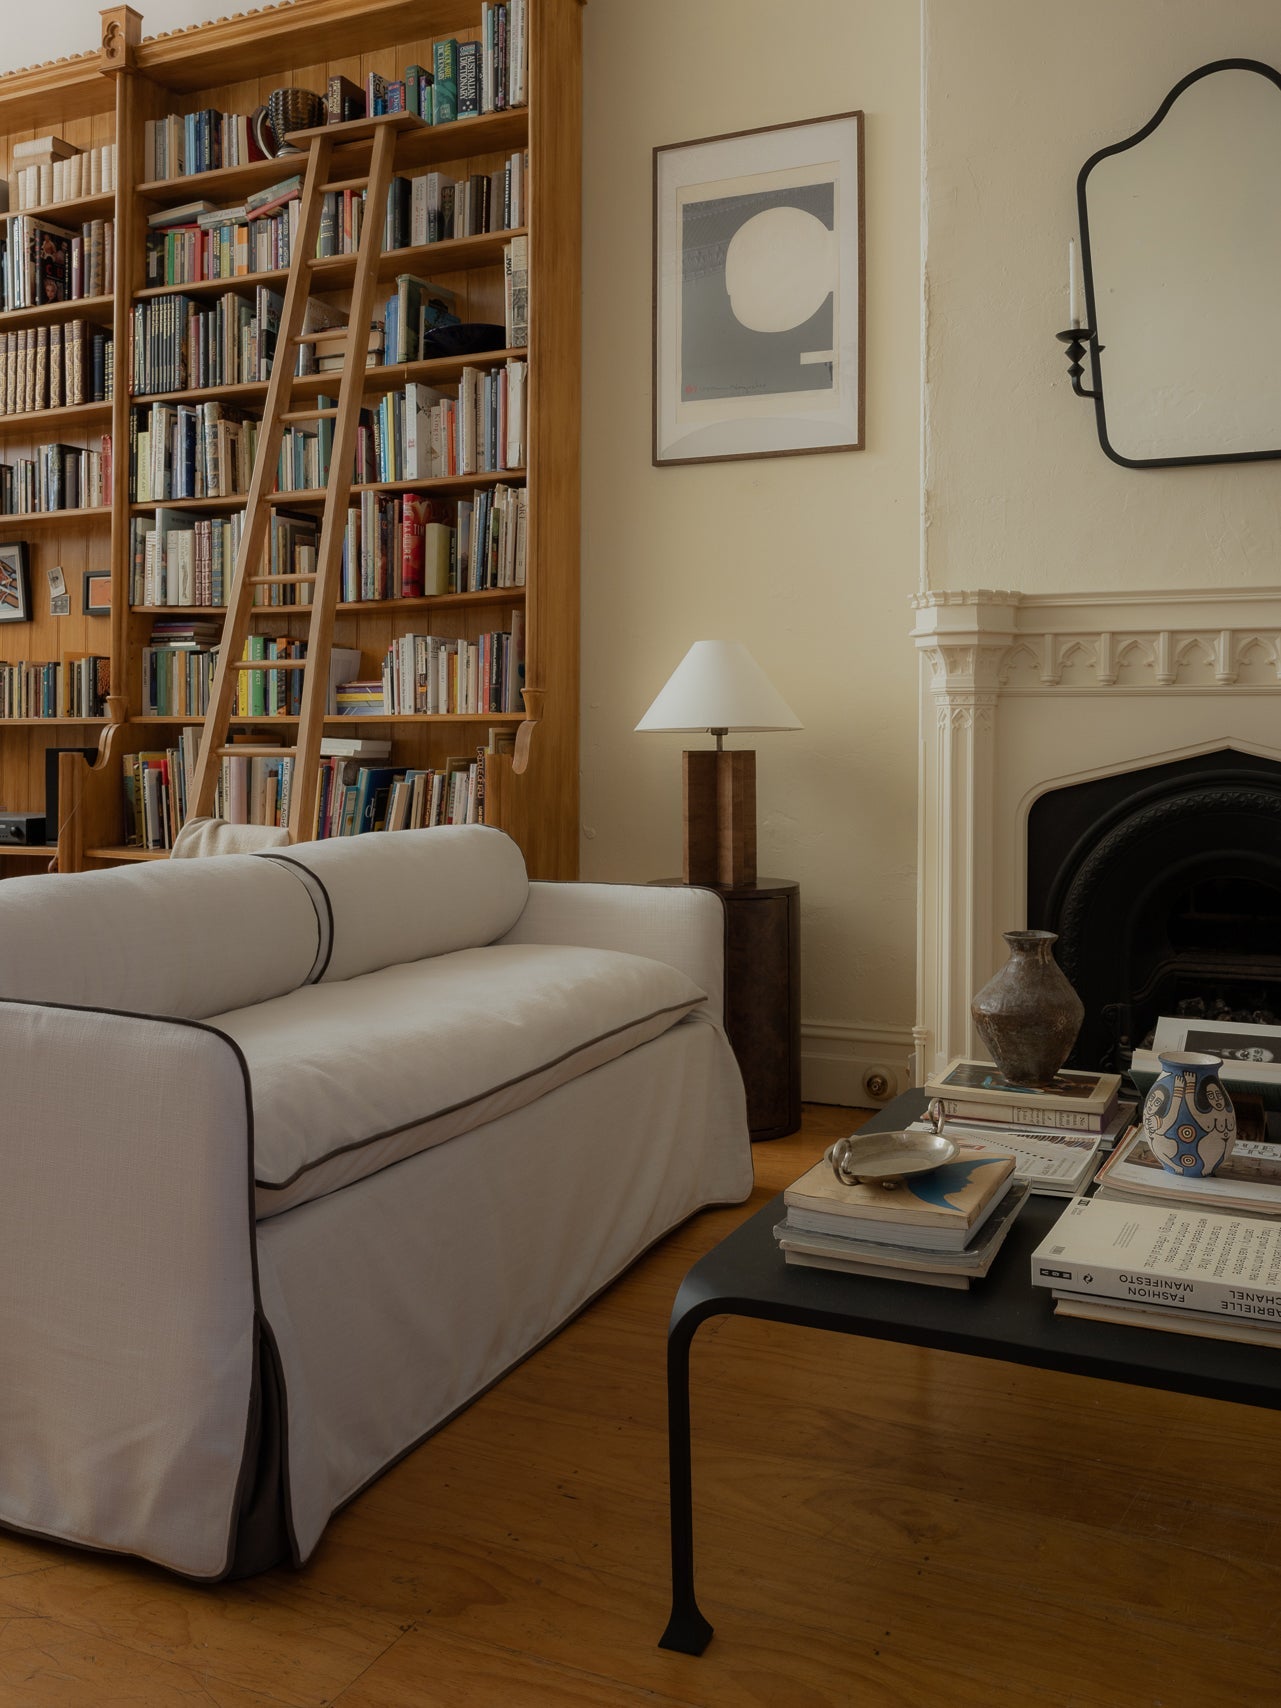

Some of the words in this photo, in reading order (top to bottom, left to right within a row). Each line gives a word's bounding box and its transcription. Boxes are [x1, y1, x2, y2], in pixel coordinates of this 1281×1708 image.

[460, 57, 468, 99] DICTIONARY
[467, 56, 476, 98] AUSTRALIAN
[1079, 1116, 1086, 1126] No
[1119, 1274, 1194, 1292] MANIFESTO
[1128, 1286, 1186, 1303] FASHION
[1229, 1290, 1281, 1306] CHANEL
[1221, 1300, 1281, 1317] ABRIELLE
